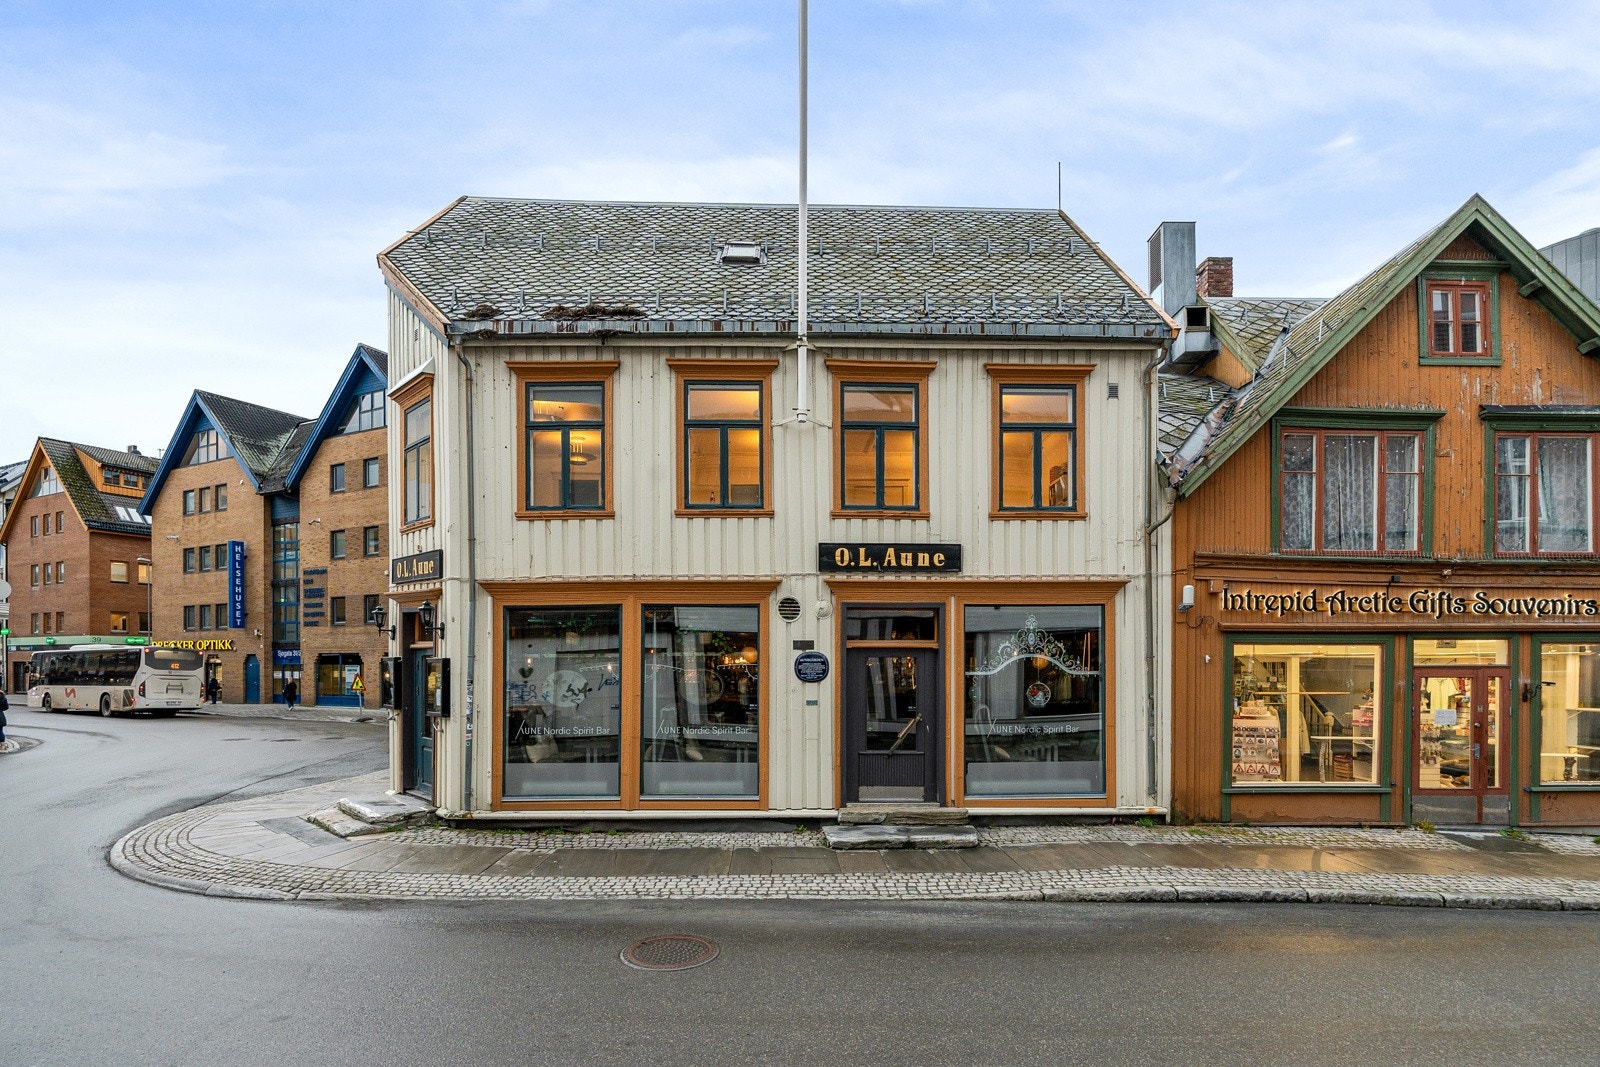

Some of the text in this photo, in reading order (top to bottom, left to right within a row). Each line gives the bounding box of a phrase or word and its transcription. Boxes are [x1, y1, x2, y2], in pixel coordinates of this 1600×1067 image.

[834, 547, 946, 567] O.L. Aune
[412, 558, 434, 577] Aune
[234, 545, 242, 626] HELSEHUSET
[1221, 587, 1599, 619] Intrepid Arctic Gifts Souvenirs
[196, 639, 232, 650] OPTIKK
[543, 726, 571, 735] Nordic
[572, 726, 594, 737] Spirit
[596, 726, 610, 735] Bar
[682, 726, 710, 735] Nordic
[711, 726, 733, 737] Spirit
[735, 726, 750, 735] Bar
[1014, 724, 1042, 733] Nordic
[1043, 724, 1064, 735] Spirit
[1065, 724, 1080, 733] Bar
